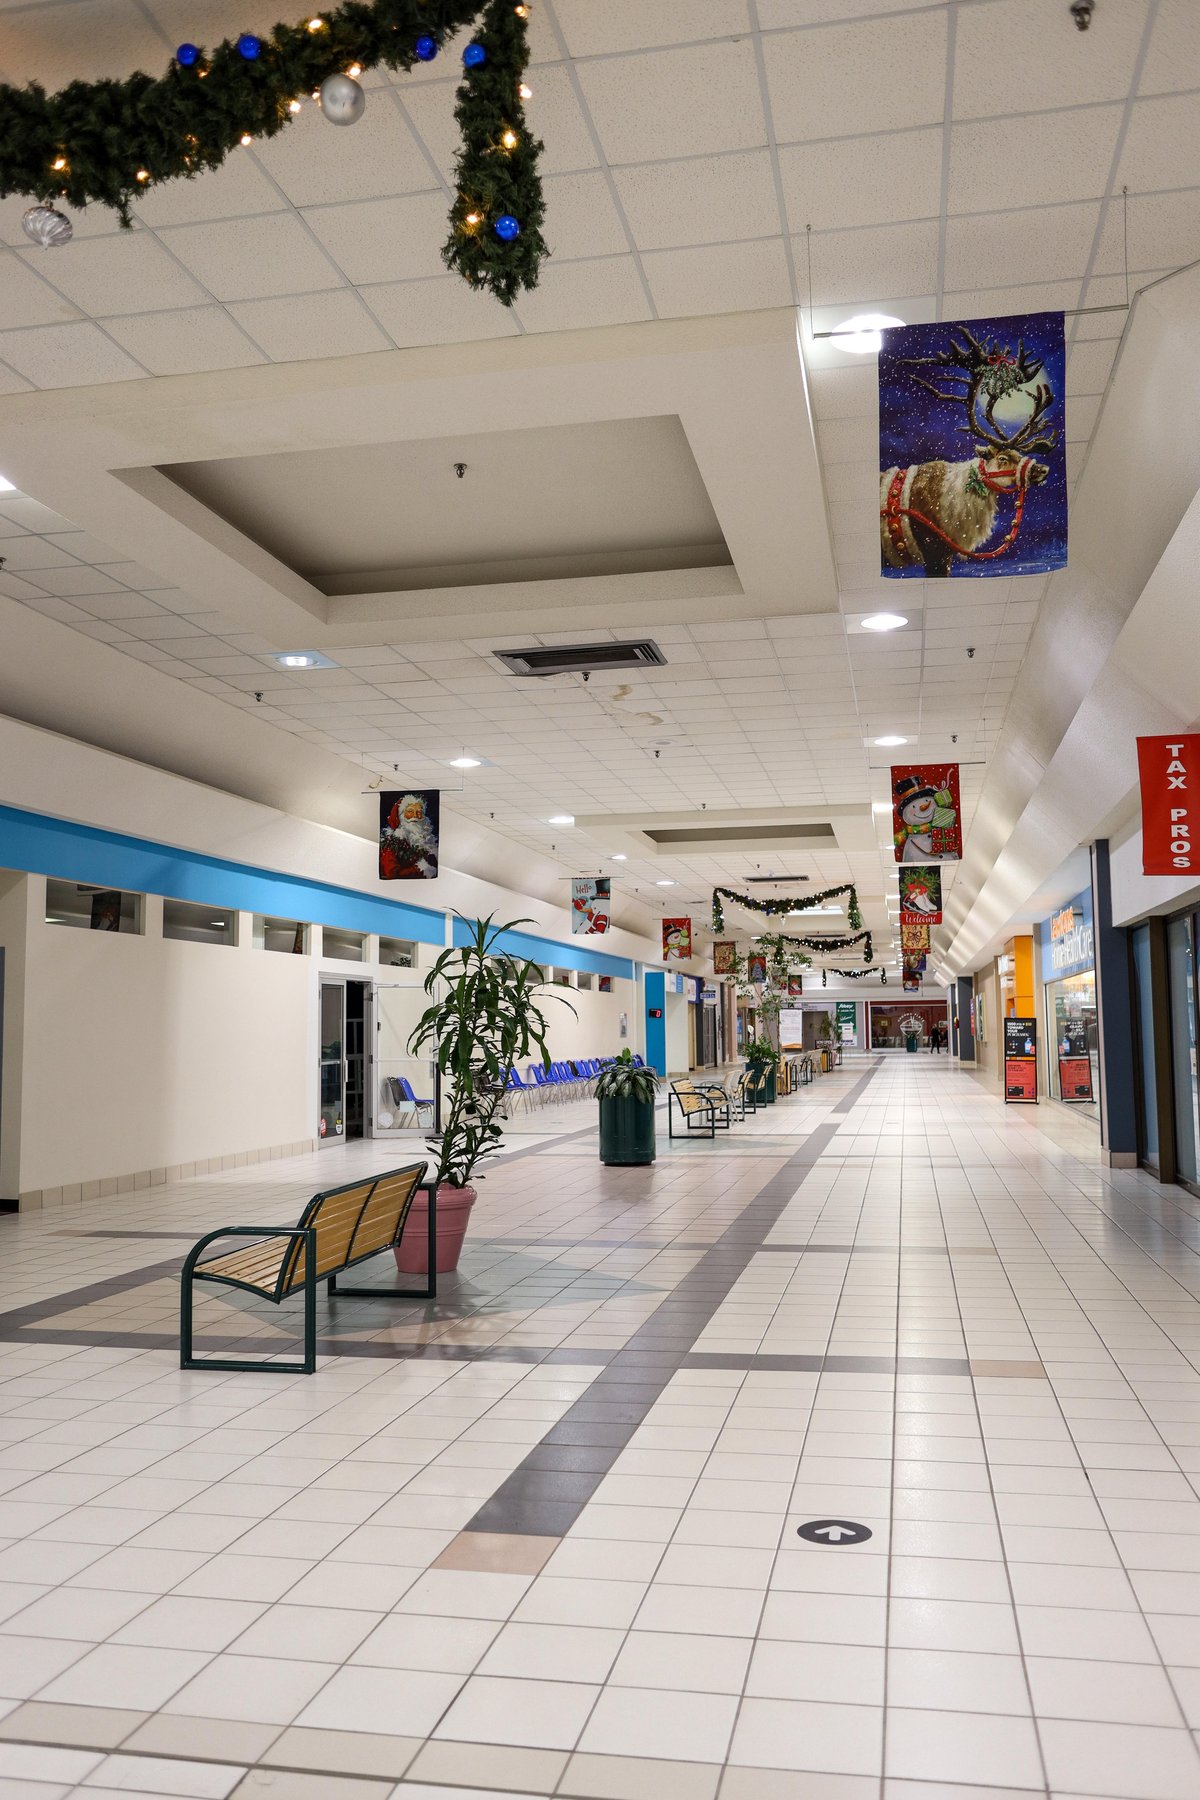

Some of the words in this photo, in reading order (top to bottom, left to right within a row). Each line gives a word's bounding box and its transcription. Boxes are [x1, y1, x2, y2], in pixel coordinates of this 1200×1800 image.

[1165, 744, 1188, 790] TAX
[1170, 808, 1191, 868] PROS
[575, 883, 592, 894] Hello
[905, 913, 938, 923] Welcome
